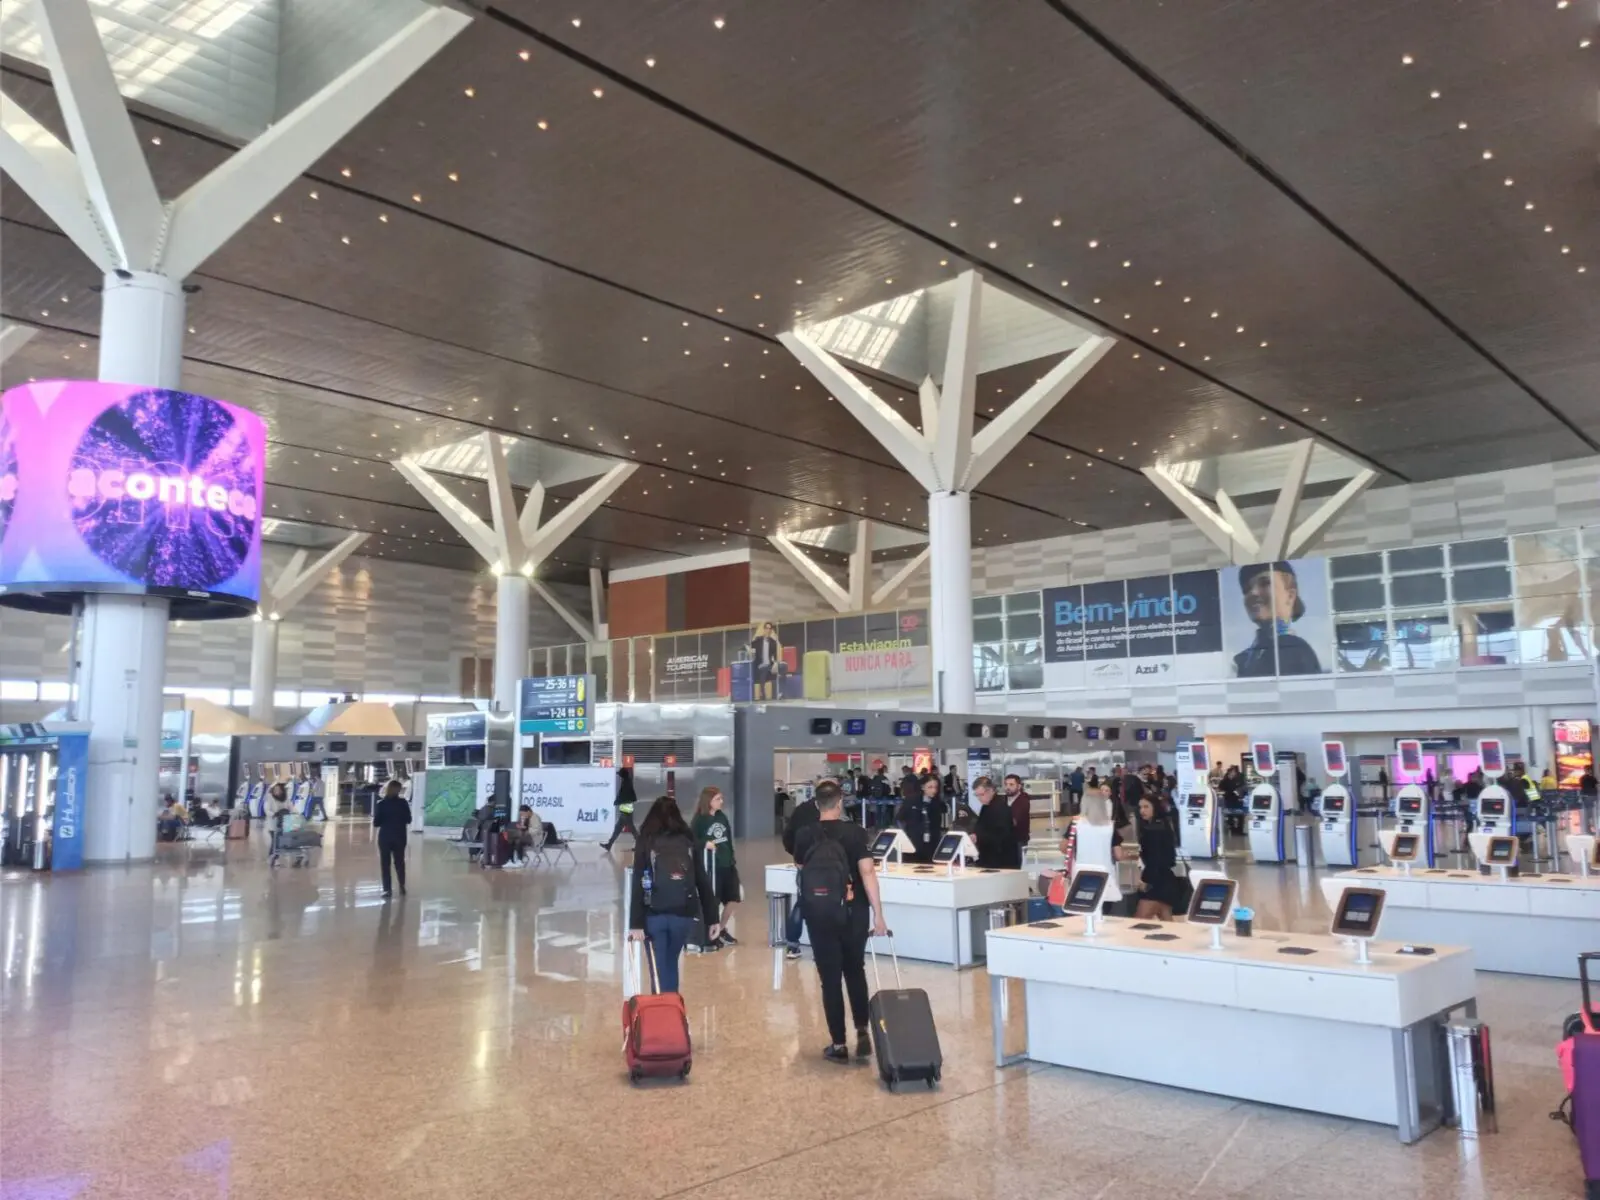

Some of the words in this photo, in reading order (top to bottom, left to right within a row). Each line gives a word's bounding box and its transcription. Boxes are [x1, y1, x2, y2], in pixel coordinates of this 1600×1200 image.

[1054, 589, 1197, 626] Bem-vindo
[839, 640, 864, 653] Esta
[666, 654, 709, 664] AMERICAN
[845, 655, 880, 672] NUNCA
[884, 651, 912, 669] PARA
[1136, 664, 1158, 674] Azul
[545, 678, 567, 690] 25-36
[550, 707, 566, 718] 1-24
[61, 766, 77, 823] Hudson
[536, 796, 564, 808] BRASIL
[577, 808, 599, 822] Azul
